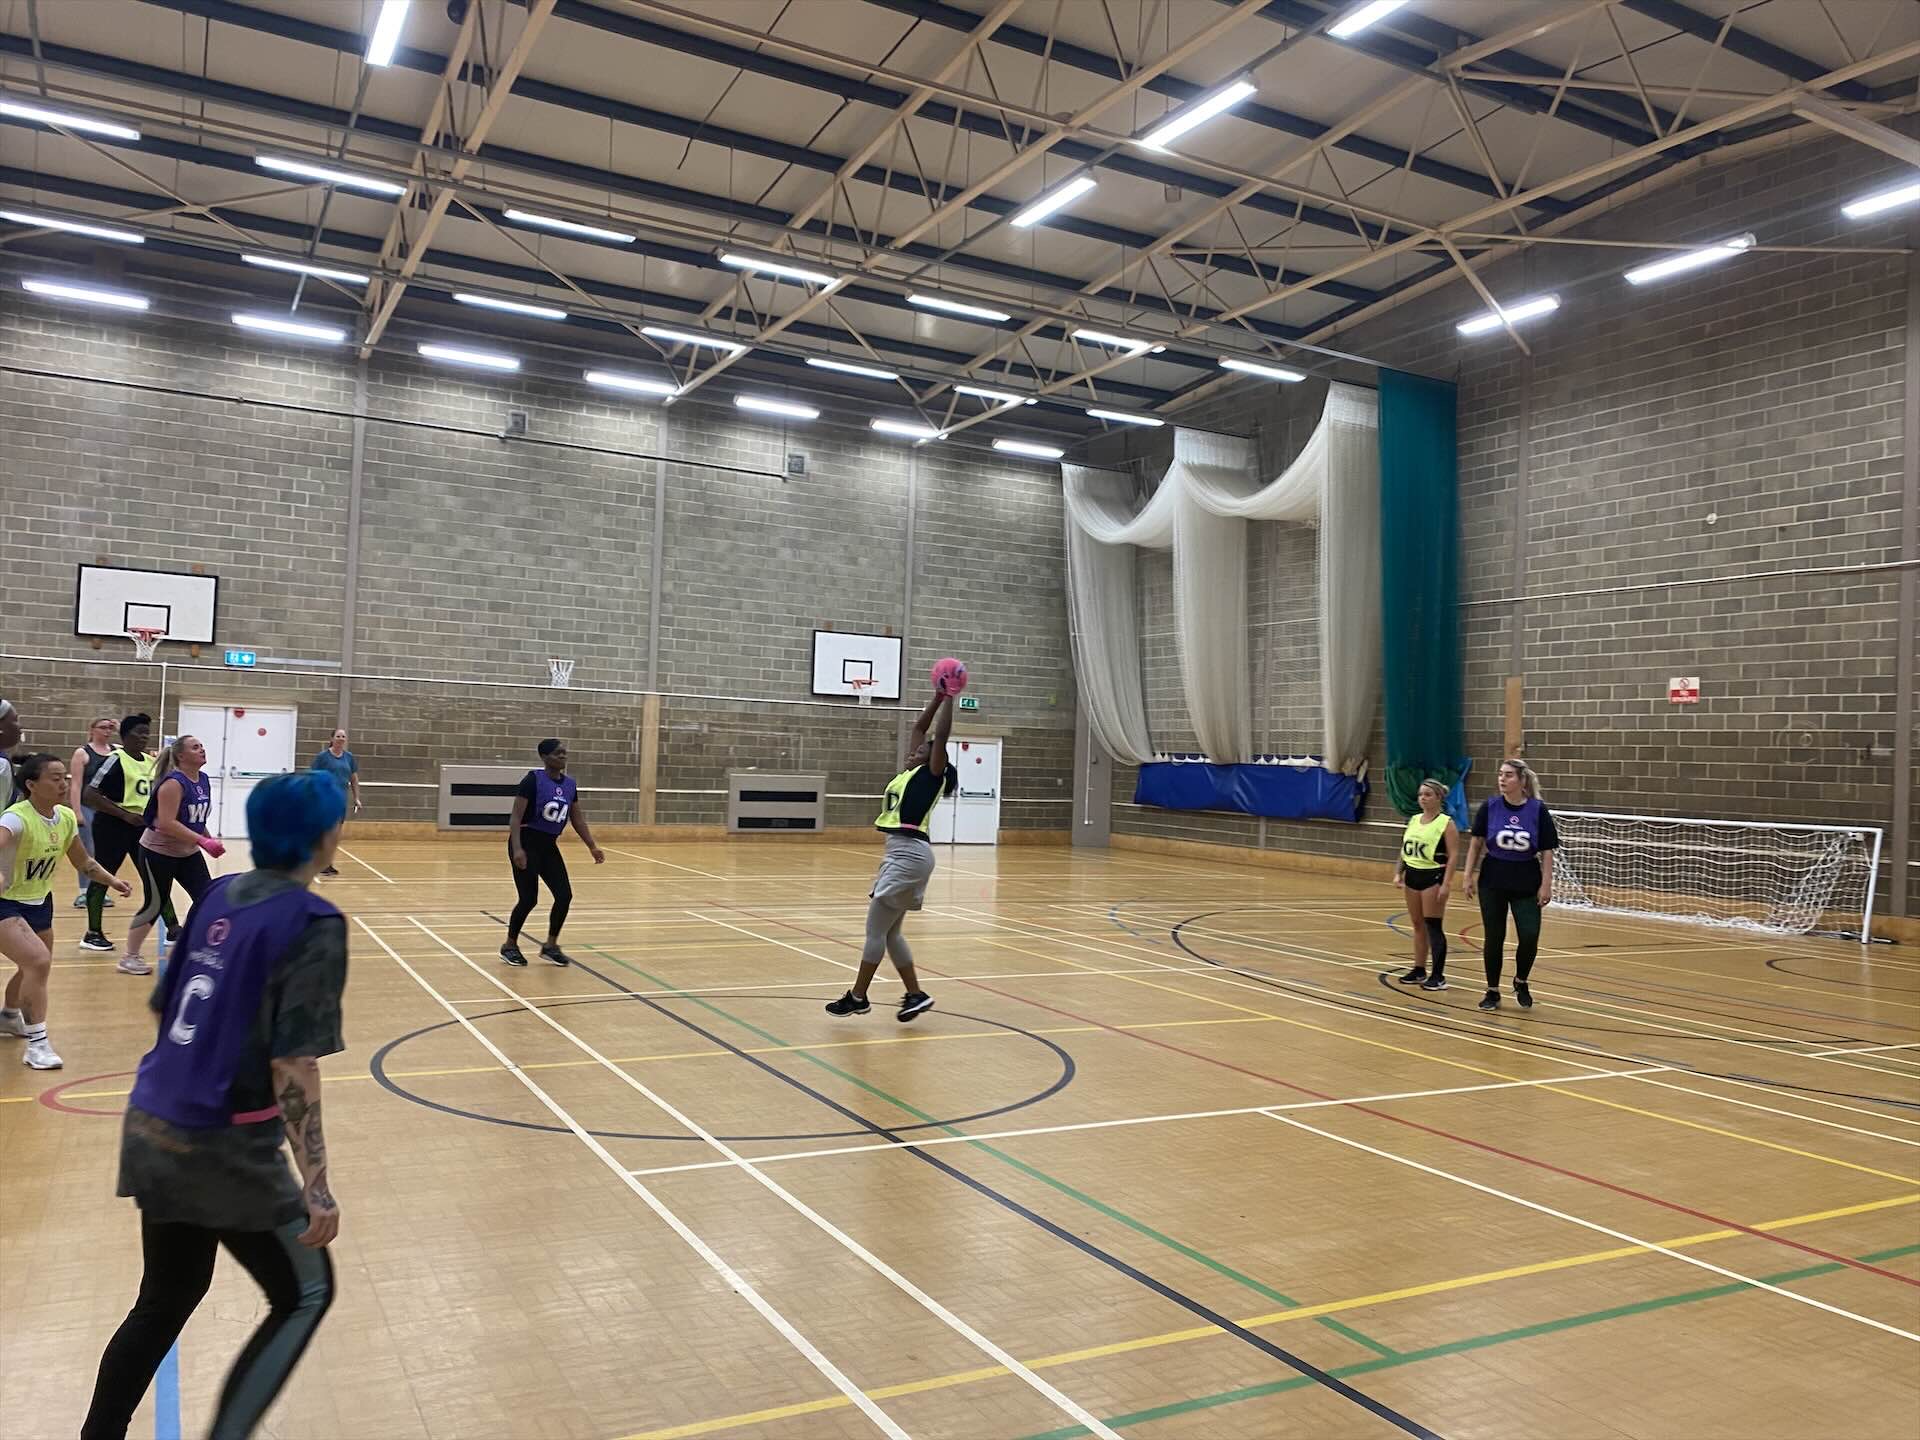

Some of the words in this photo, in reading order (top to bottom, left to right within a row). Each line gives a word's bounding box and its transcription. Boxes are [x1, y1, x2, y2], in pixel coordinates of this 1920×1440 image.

[136, 779, 153, 796] G
[188, 802, 211, 824] W
[1404, 841, 1427, 860] GK
[1496, 829, 1530, 851] GS
[26, 856, 56, 880] W
[168, 974, 215, 1046] C
